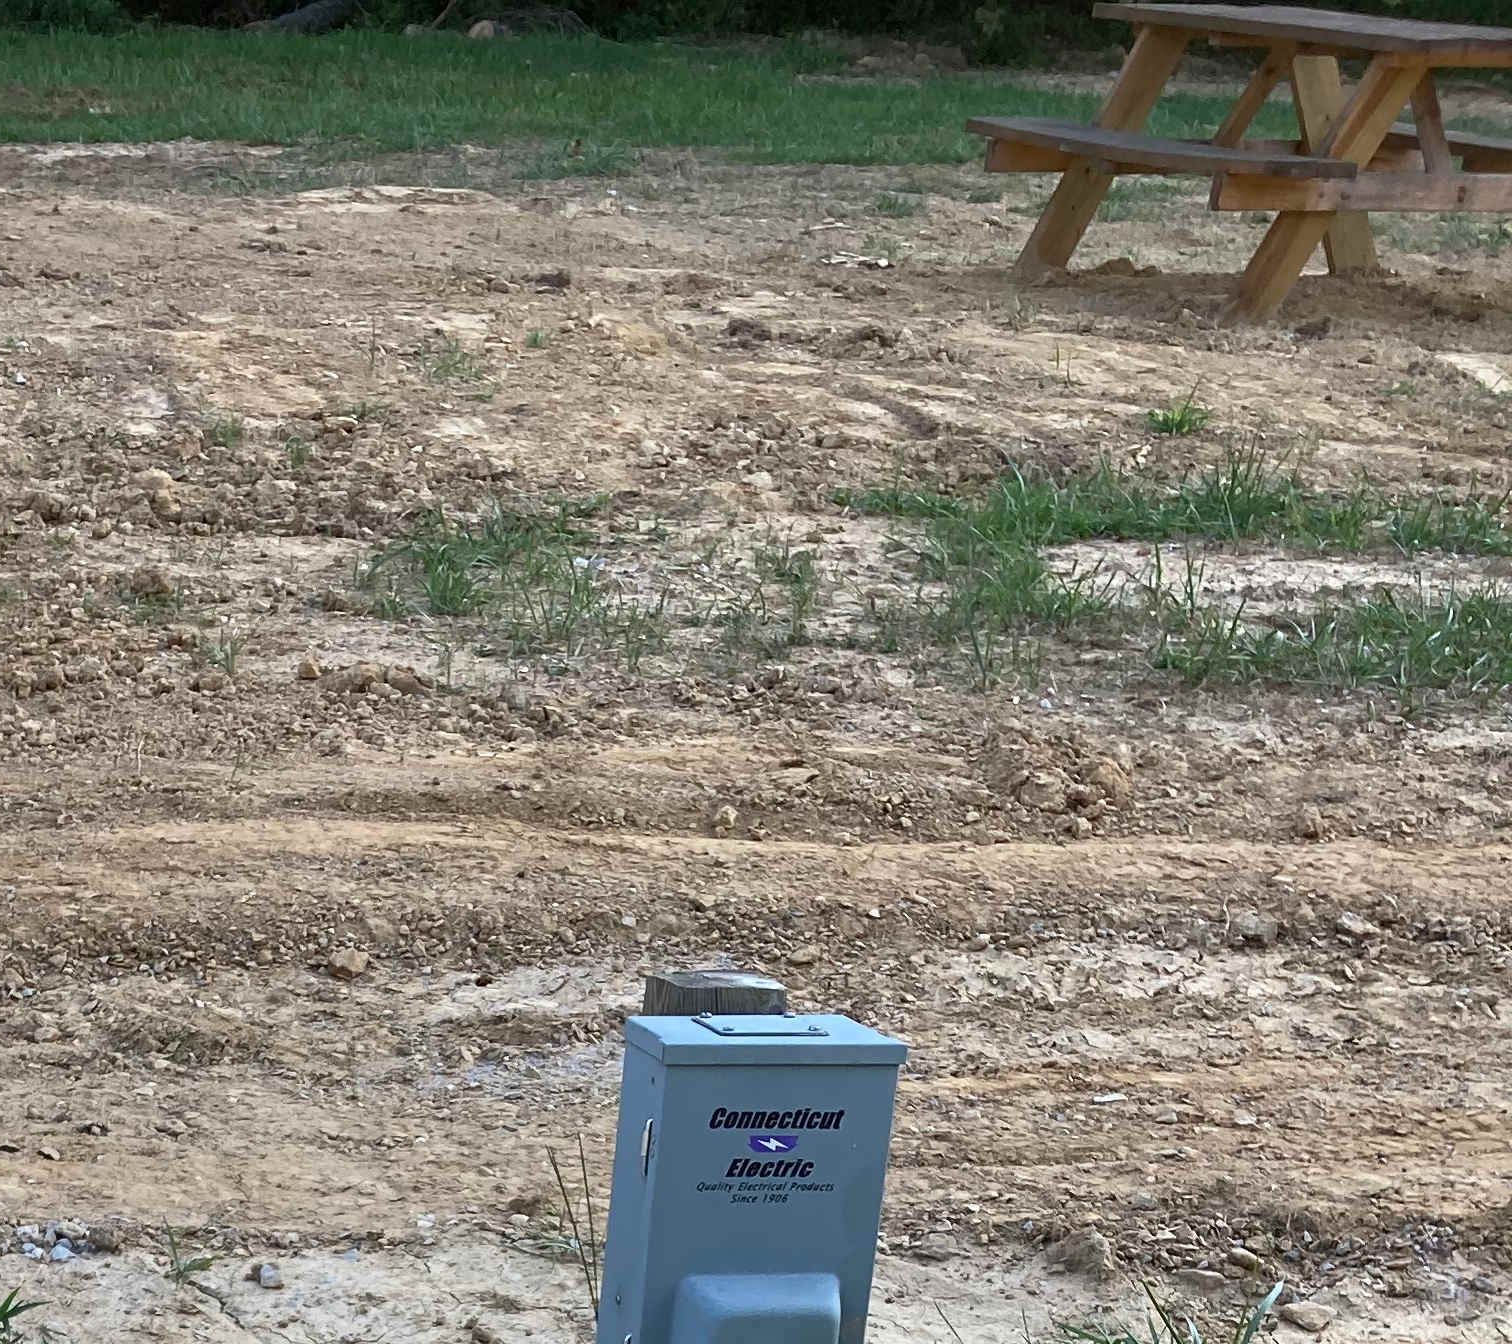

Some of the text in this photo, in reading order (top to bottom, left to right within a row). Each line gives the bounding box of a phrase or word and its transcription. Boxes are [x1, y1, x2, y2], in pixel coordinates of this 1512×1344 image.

[709, 1107, 845, 1129] Connecticut
[726, 1158, 814, 1178] Electric
[696, 1182, 834, 1193] Quality Electrical Products
[730, 1194, 788, 1204] Since 1906
